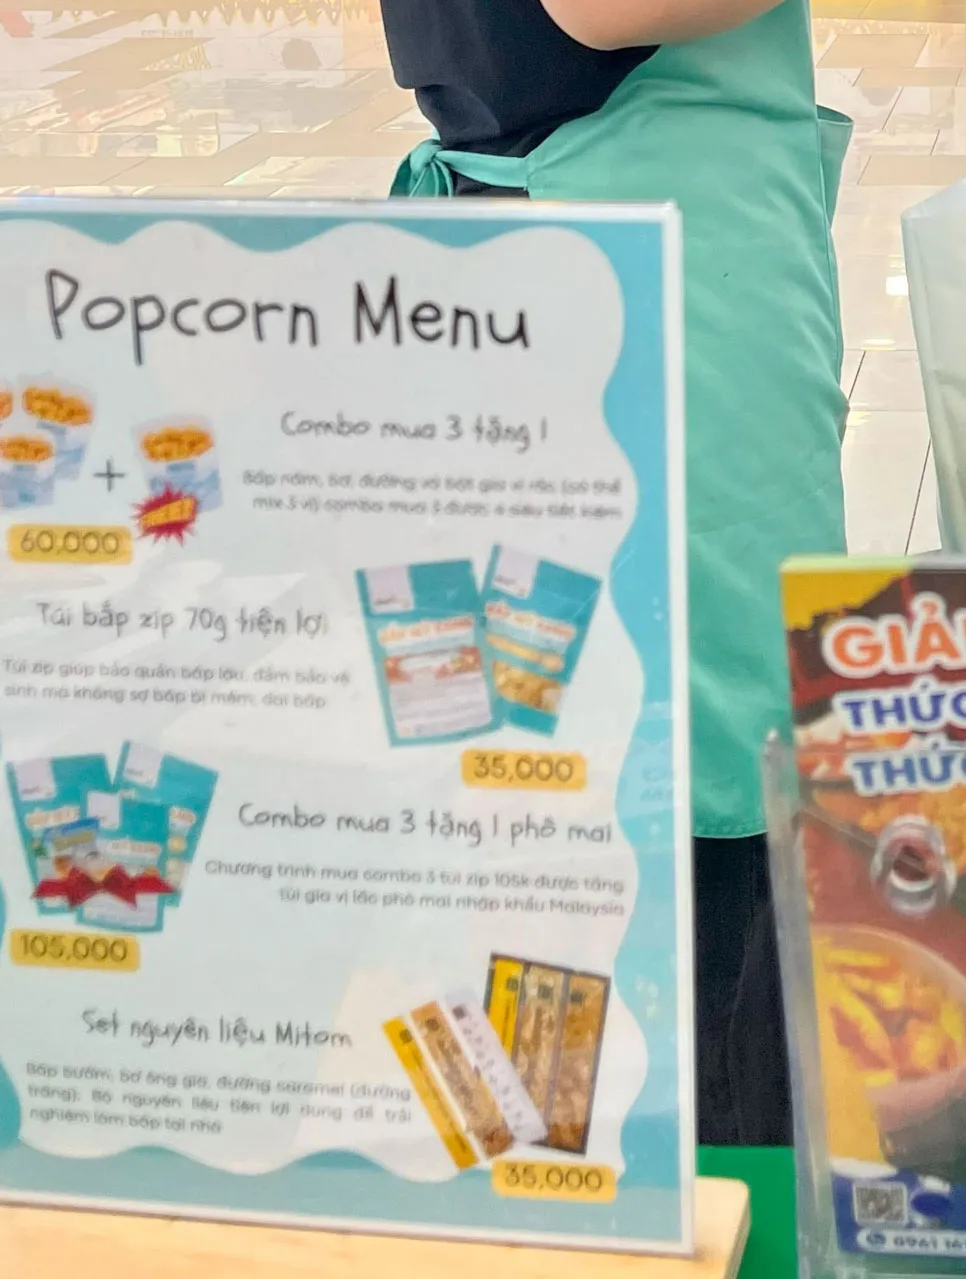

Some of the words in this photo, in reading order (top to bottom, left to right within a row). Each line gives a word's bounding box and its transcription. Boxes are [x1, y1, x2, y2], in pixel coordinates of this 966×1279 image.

[45, 269, 318, 365] Popcorn
[354, 275, 530, 349] Menu
[281, 411, 371, 438] Combo
[380, 421, 436, 440] mua
[445, 415, 463, 441] 3
[37, 602, 71, 627] Túi
[139, 609, 174, 639] zip
[184, 606, 228, 642] 70g
[474, 752, 574, 783] 35,000
[238, 802, 326, 829] Combo
[336, 816, 390, 834] mua
[400, 808, 416, 835] 3
[510, 813, 558, 848] phô
[567, 820, 613, 844] mai
[20, 933, 129, 963] 105,000
[81, 1009, 119, 1036] Set
[129, 1019, 210, 1048] nguyên
[219, 1017, 266, 1049] liệu
[275, 1021, 353, 1050] Mitom
[505, 1163, 603, 1193] 35,000
